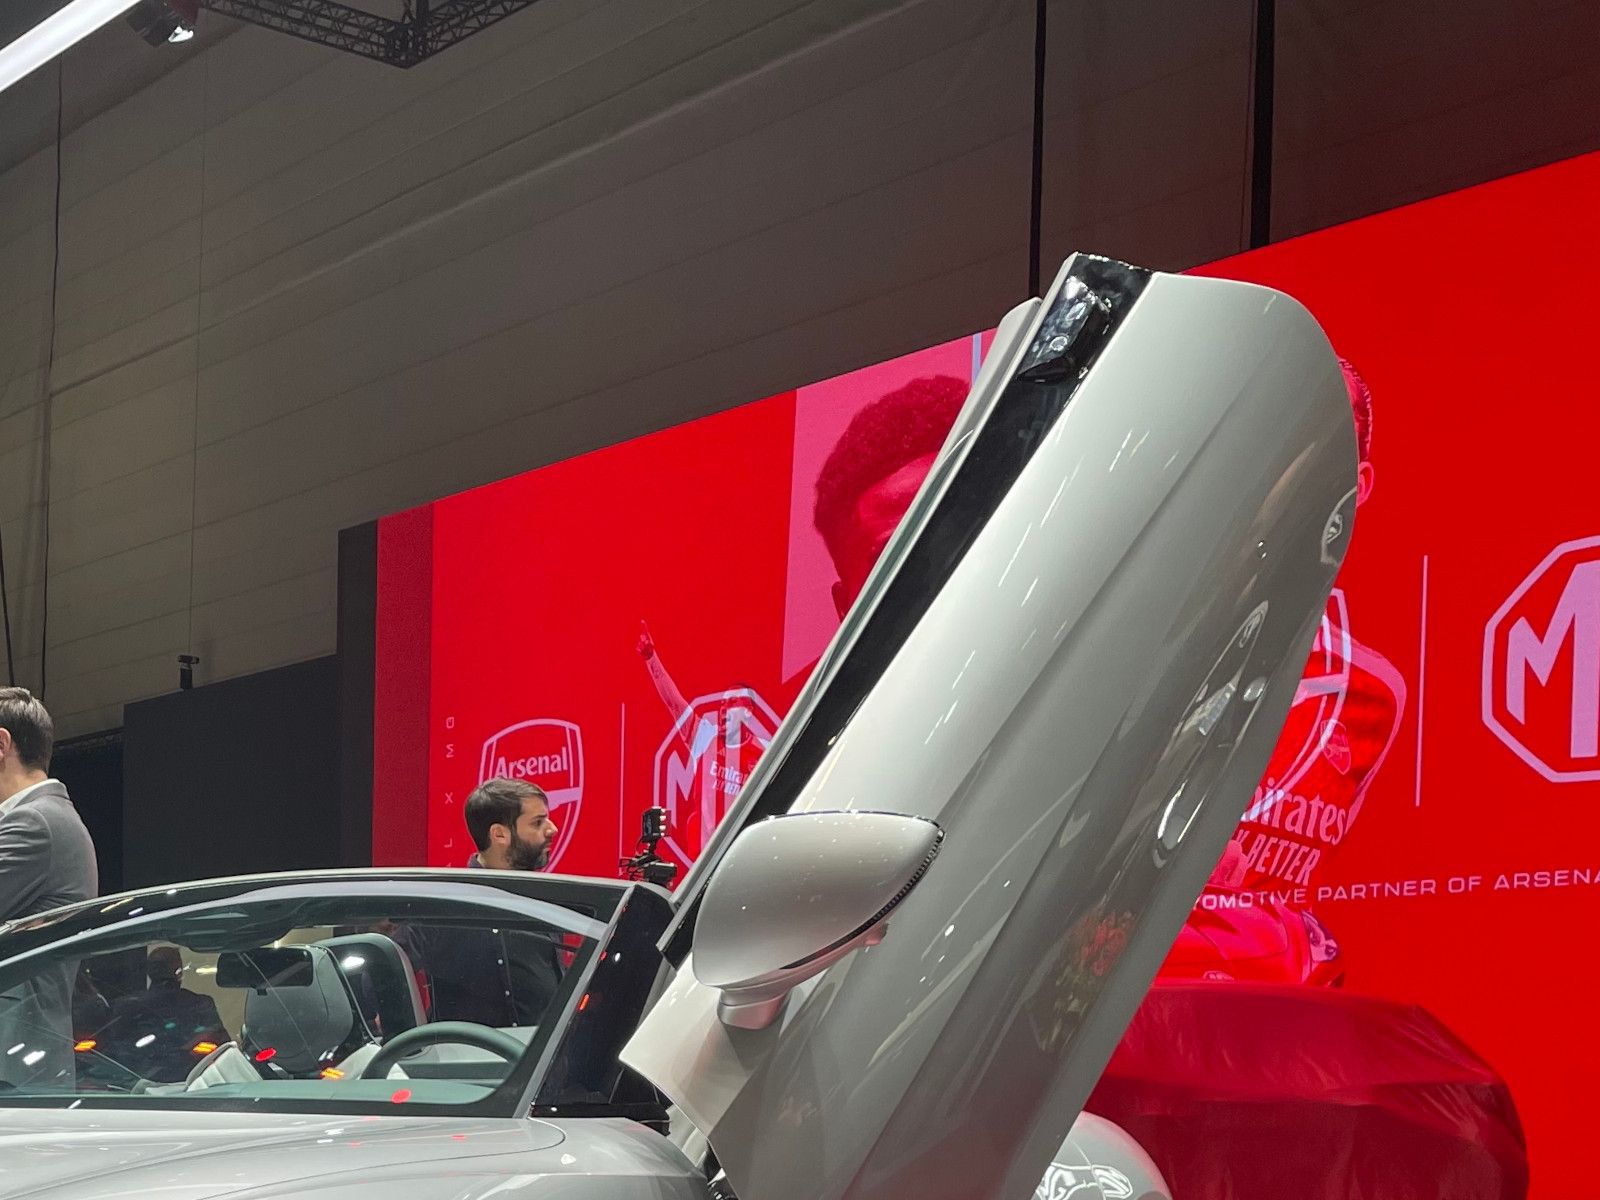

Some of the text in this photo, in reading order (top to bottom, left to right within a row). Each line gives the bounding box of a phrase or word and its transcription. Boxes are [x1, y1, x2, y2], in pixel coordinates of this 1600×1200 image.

[1506, 559, 1600, 759] M
[495, 746, 570, 779] Arsenal
[1248, 777, 1348, 846] irates
[1193, 886, 1307, 911] OMOTIVE
[1317, 879, 1436, 902] PARTNER
[1447, 876, 1482, 894] OF
